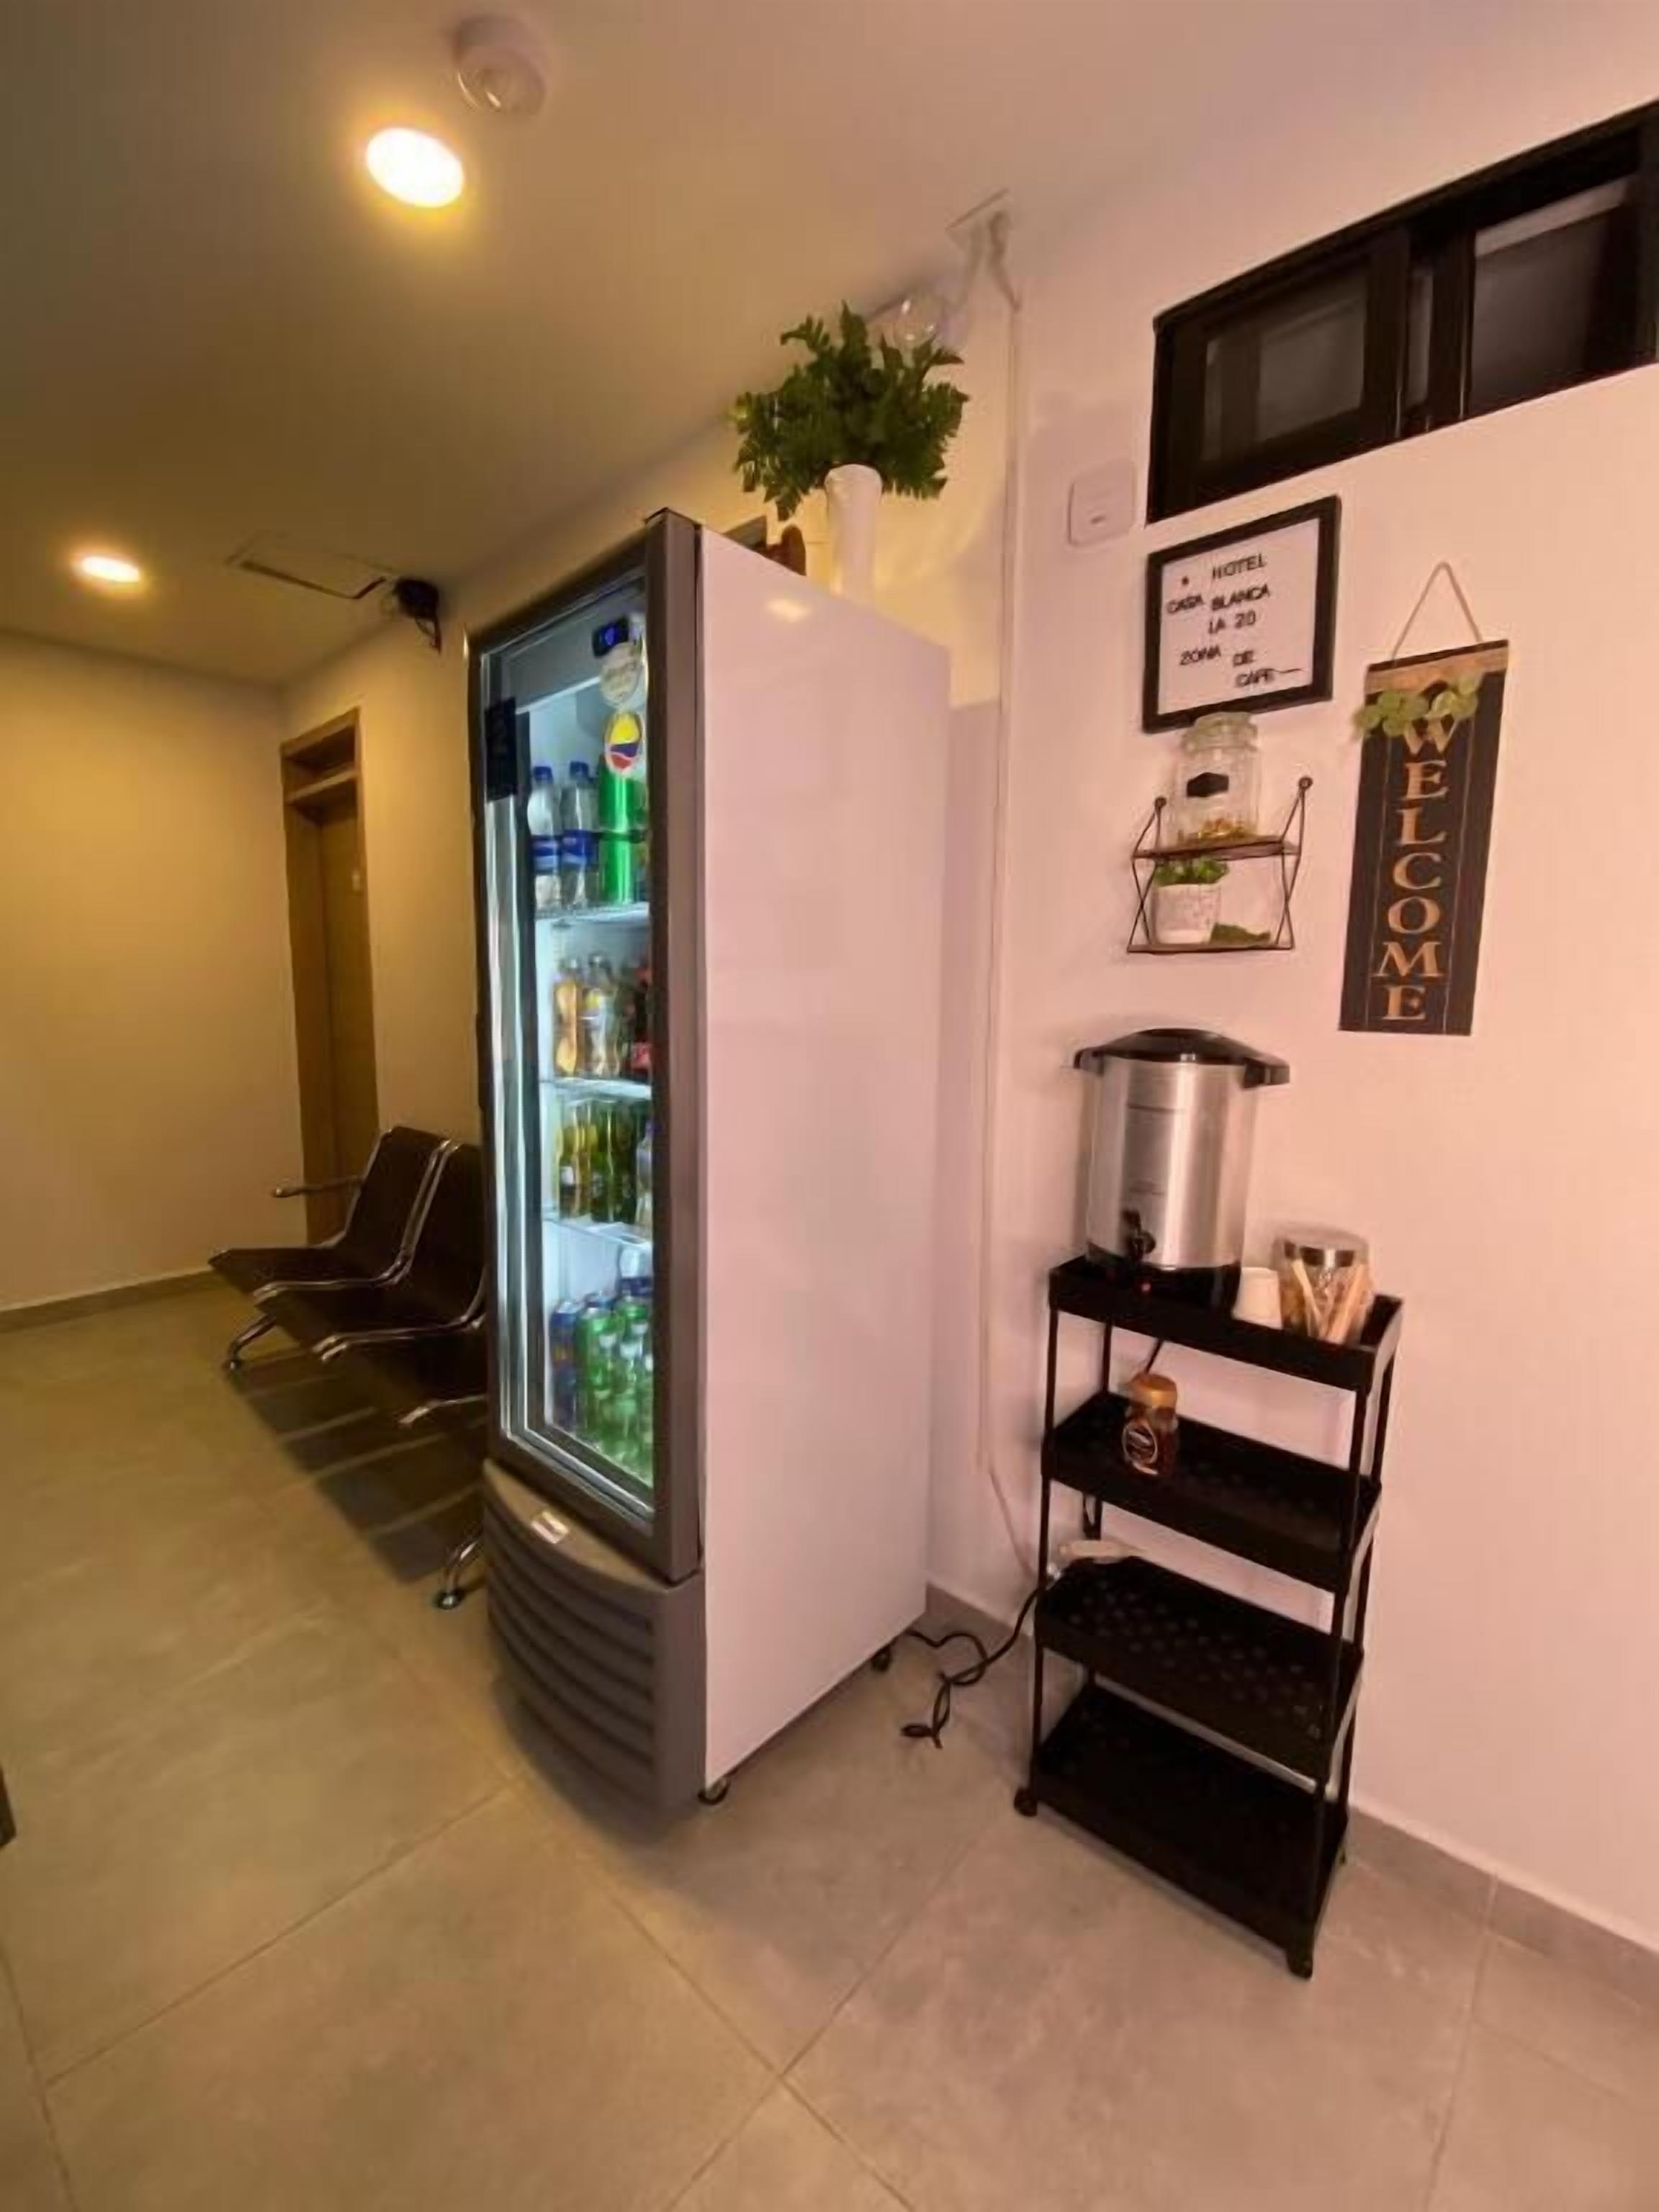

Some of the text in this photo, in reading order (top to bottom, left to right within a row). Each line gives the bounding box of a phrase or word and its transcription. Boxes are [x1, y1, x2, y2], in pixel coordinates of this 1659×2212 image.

[1213, 552, 1267, 579] HOTEL
[1166, 584, 1270, 614] CASA BLANCA
[1208, 619, 1226, 634] LA
[1179, 646, 1254, 667] ZONA DE
[1372, 711, 1462, 1021] WELCOME
